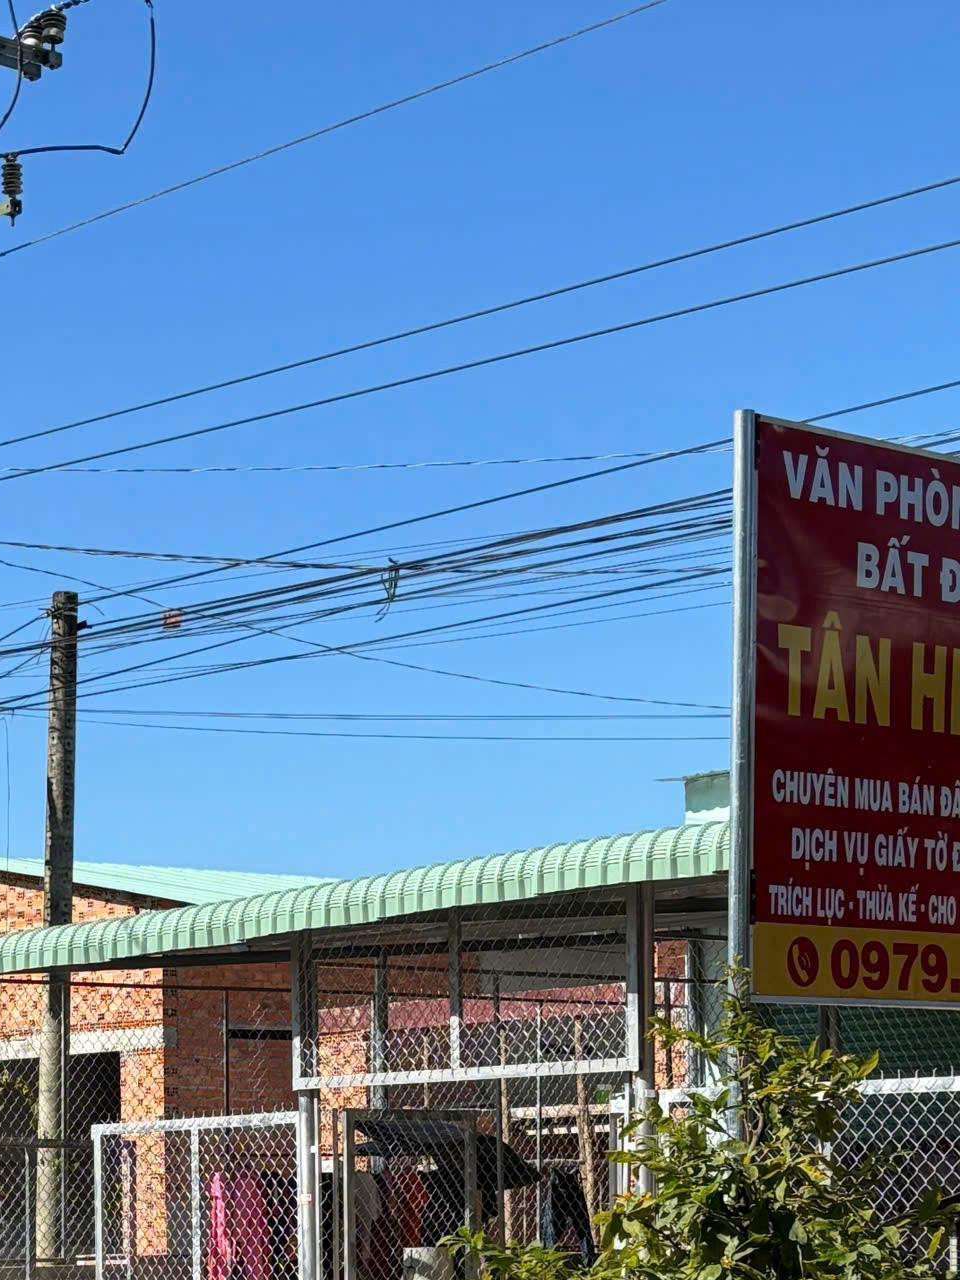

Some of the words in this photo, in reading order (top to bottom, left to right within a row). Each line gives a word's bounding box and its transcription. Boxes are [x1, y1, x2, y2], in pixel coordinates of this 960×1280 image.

[783, 445, 863, 512] VĂN
[856, 535, 929, 598] BẤT
[777, 610, 892, 727] TÂN
[772, 768, 849, 809] CHUYÊN
[854, 778, 893, 813] MUA
[898, 776, 934, 816] BÁN
[791, 827, 838, 871] DỊCH
[843, 831, 869, 876] VỤ
[874, 826, 920, 869] GIẤY
[924, 831, 948, 872] TỜ
[768, 878, 813, 917] TRÍCH
[816, 887, 845, 926] LỤC
[856, 883, 894, 922] THỪA
[898, 883, 920, 923] KẾ
[928, 894, 957, 926] CHO
